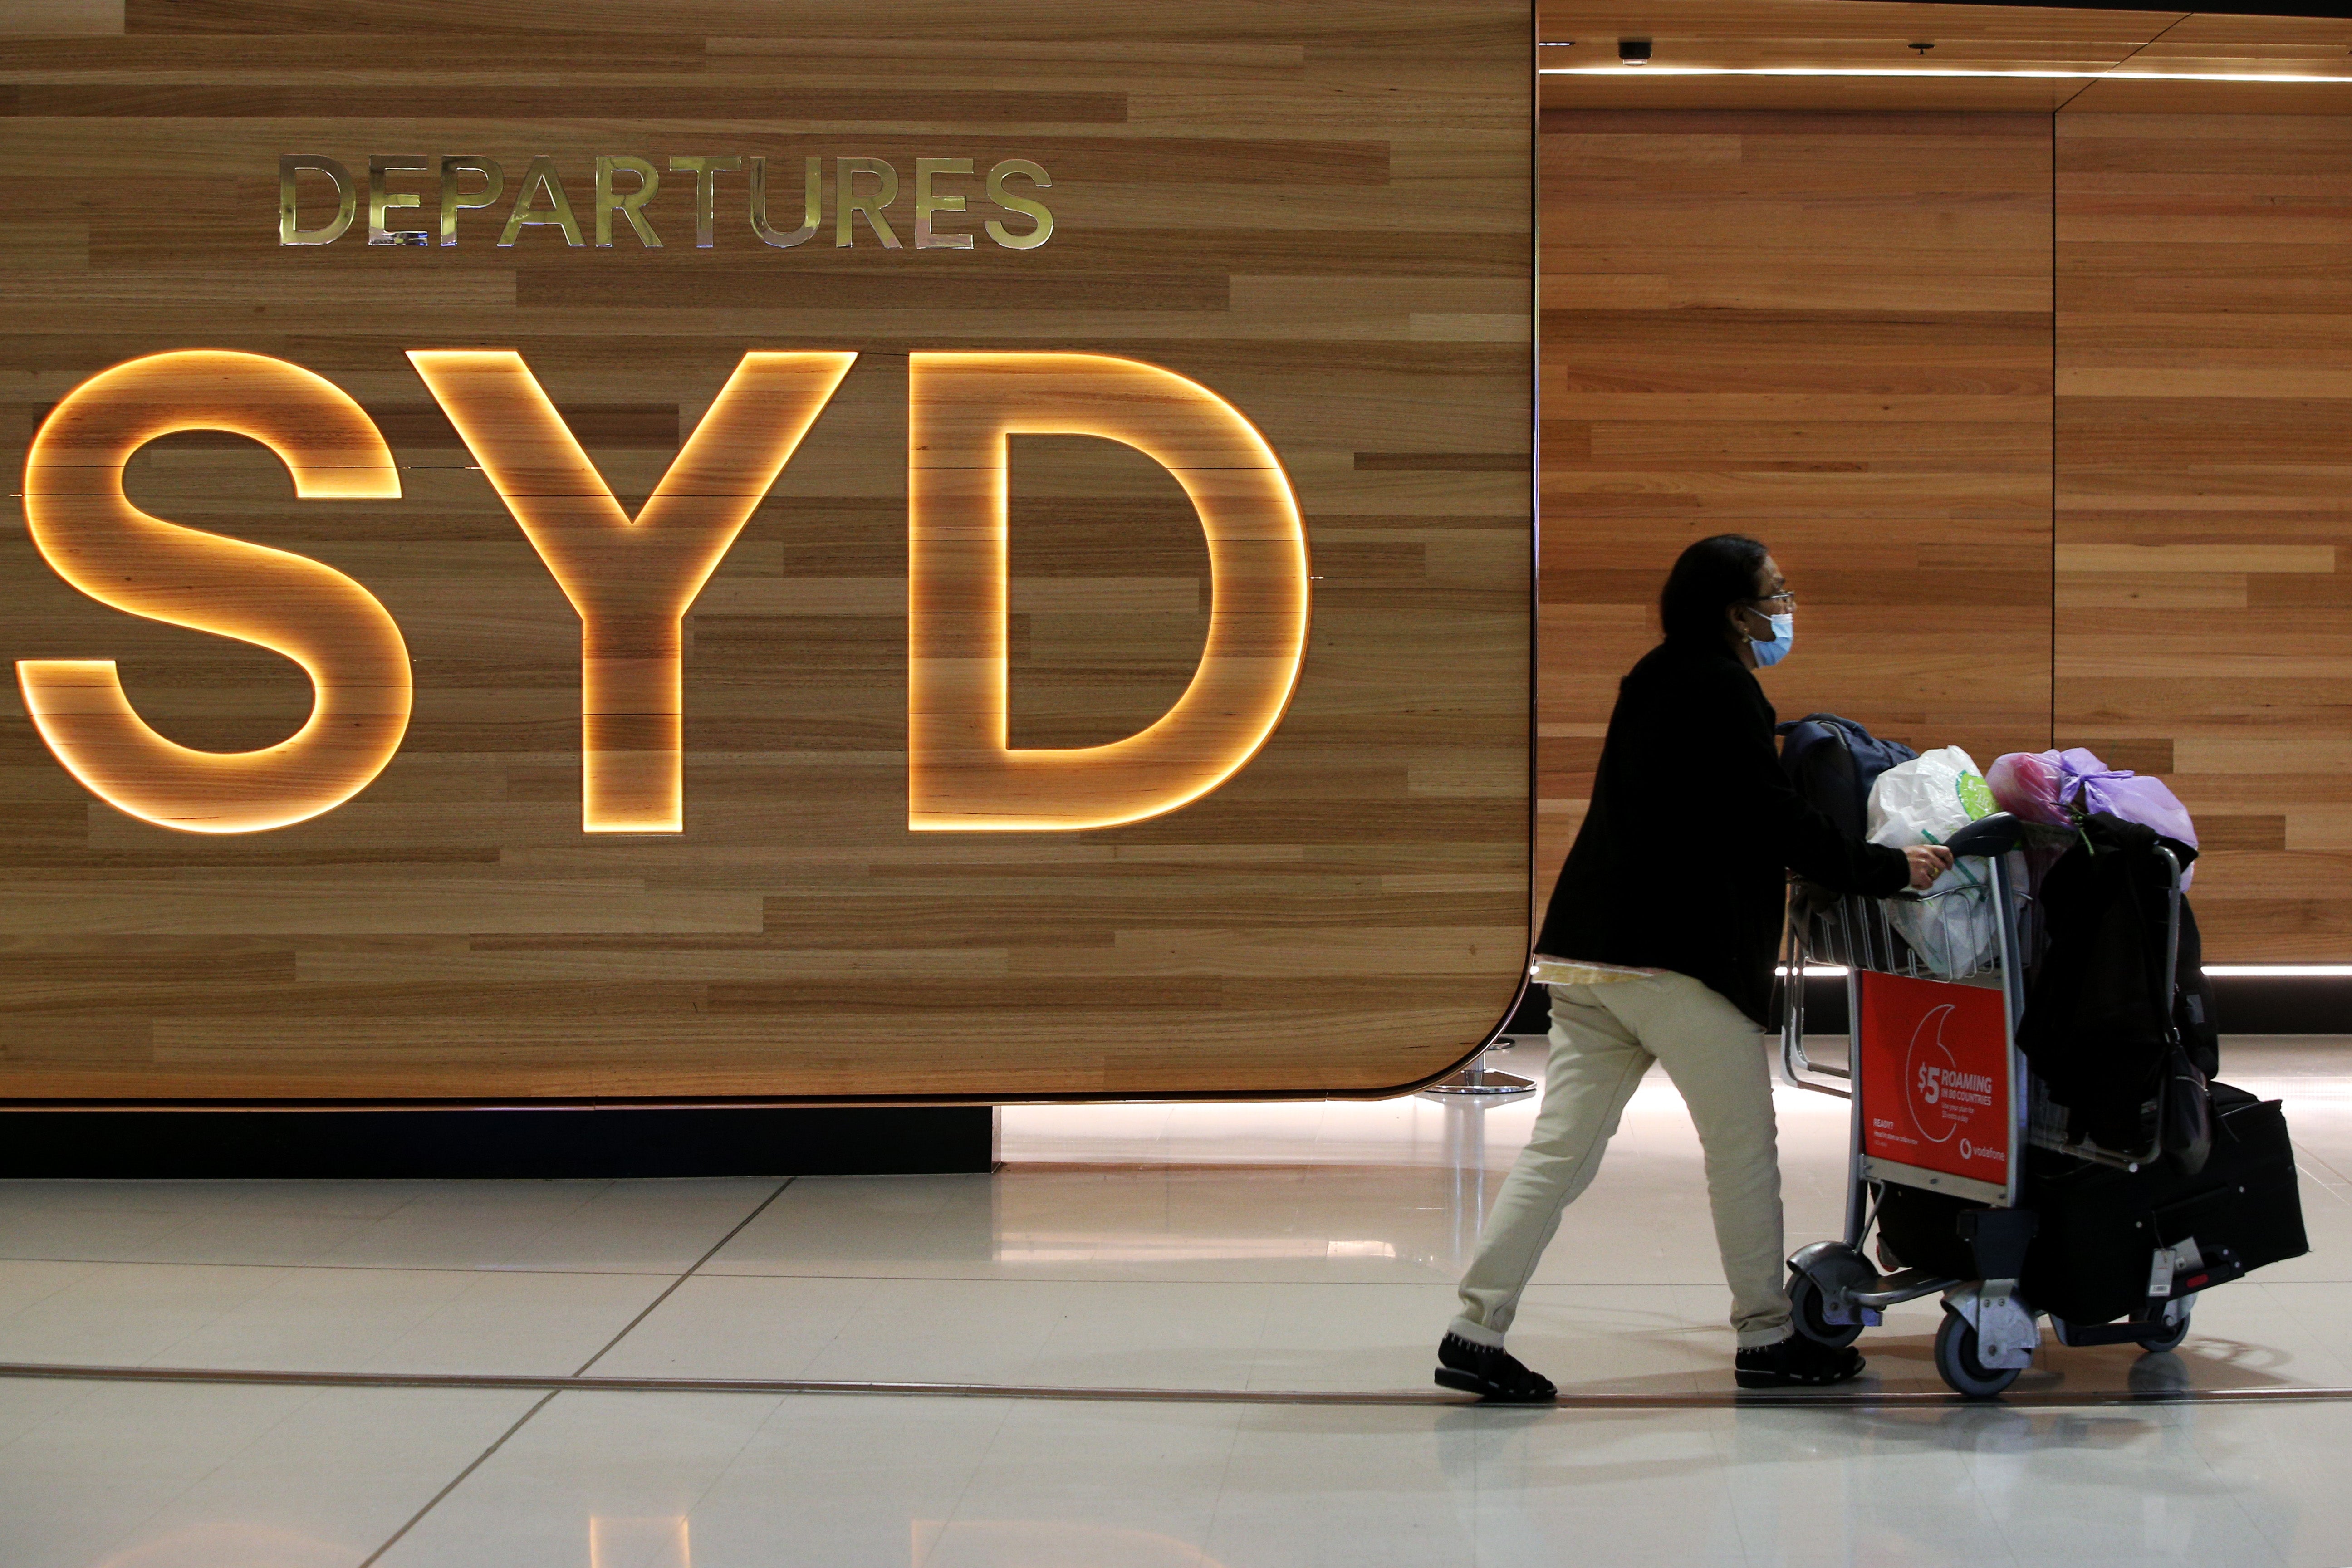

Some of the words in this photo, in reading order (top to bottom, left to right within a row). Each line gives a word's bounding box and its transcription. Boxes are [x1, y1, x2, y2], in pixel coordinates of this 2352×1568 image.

[279, 154, 1054, 250] DEPARTURES
[15, 349, 1310, 834] SYD
[1917, 1062, 1940, 1104] $5
[1941, 1069, 1992, 1093] ROAMING
[1941, 1088, 1948, 1098] IN
[1956, 1091, 1991, 1106] COUNTRIES
[1873, 1118, 1893, 1129] READY?
[1973, 1146, 2005, 1161] vodafone
